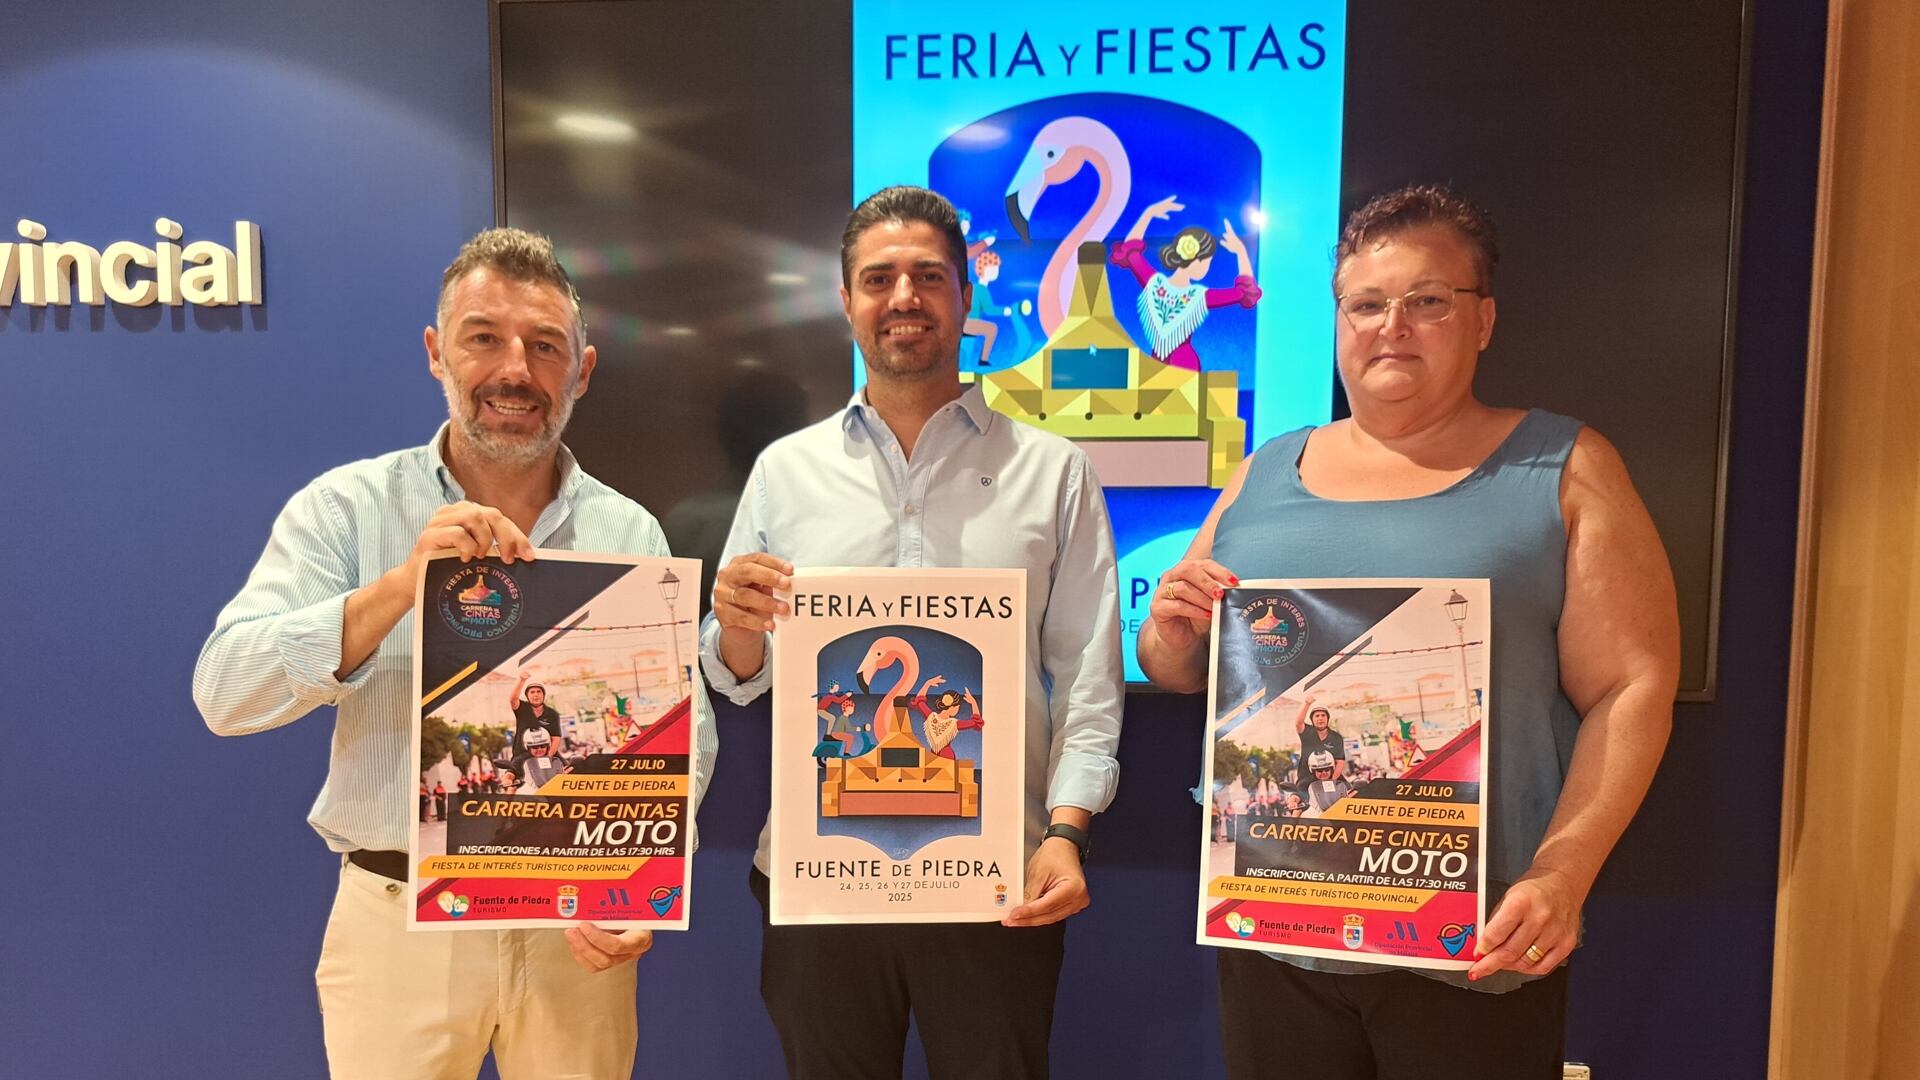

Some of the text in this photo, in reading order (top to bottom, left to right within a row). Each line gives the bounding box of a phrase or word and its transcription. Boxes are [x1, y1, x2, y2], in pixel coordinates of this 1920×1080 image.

[885, 22, 1327, 80] FERIA Y FIESTAS
[446, 568, 473, 591] FIESTA
[476, 566, 489, 574] DE
[465, 610, 501, 619] CINTAS
[794, 595, 1013, 619] FERIA Y FIESTAS
[470, 617, 498, 625] MOTO
[611, 759, 666, 770] 27 JULIO
[561, 780, 676, 791] FUENTE DE PIEDRA
[1396, 784, 1453, 798] 27 JULIO
[461, 800, 680, 819] CARRERA DE CINTAS
[1345, 804, 1465, 820] FUENTE DE PIEDRA
[573, 820, 677, 846] MOTO
[1249, 822, 1470, 850] CARRERA DE CINTAS
[458, 845, 676, 857] INSCRIPCIONES A PARTIR DE LAS 17:30 HRS
[432, 860, 631, 872] FIESTA DE INTERÉS TURÍSTICO PROVINCIAL
[795, 860, 1002, 878] FUENTE DE PIEDRA
[1358, 847, 1468, 878] MOTO
[1245, 867, 1467, 890] INSCRIPCIONES A PARTIR DE LAS 17:30 HRS
[840, 883, 854, 892] 24,
[859, 882, 873, 891] 25,
[877, 882, 889, 890] 26
[1220, 883, 1419, 905] FIESTA DE INTERÉS TURÍSTICO PROVINCIAL
[473, 896, 551, 905] Fuente de Piedra
[888, 893, 912, 902] 2025
[1259, 920, 1336, 935] Fuente de Piedra
